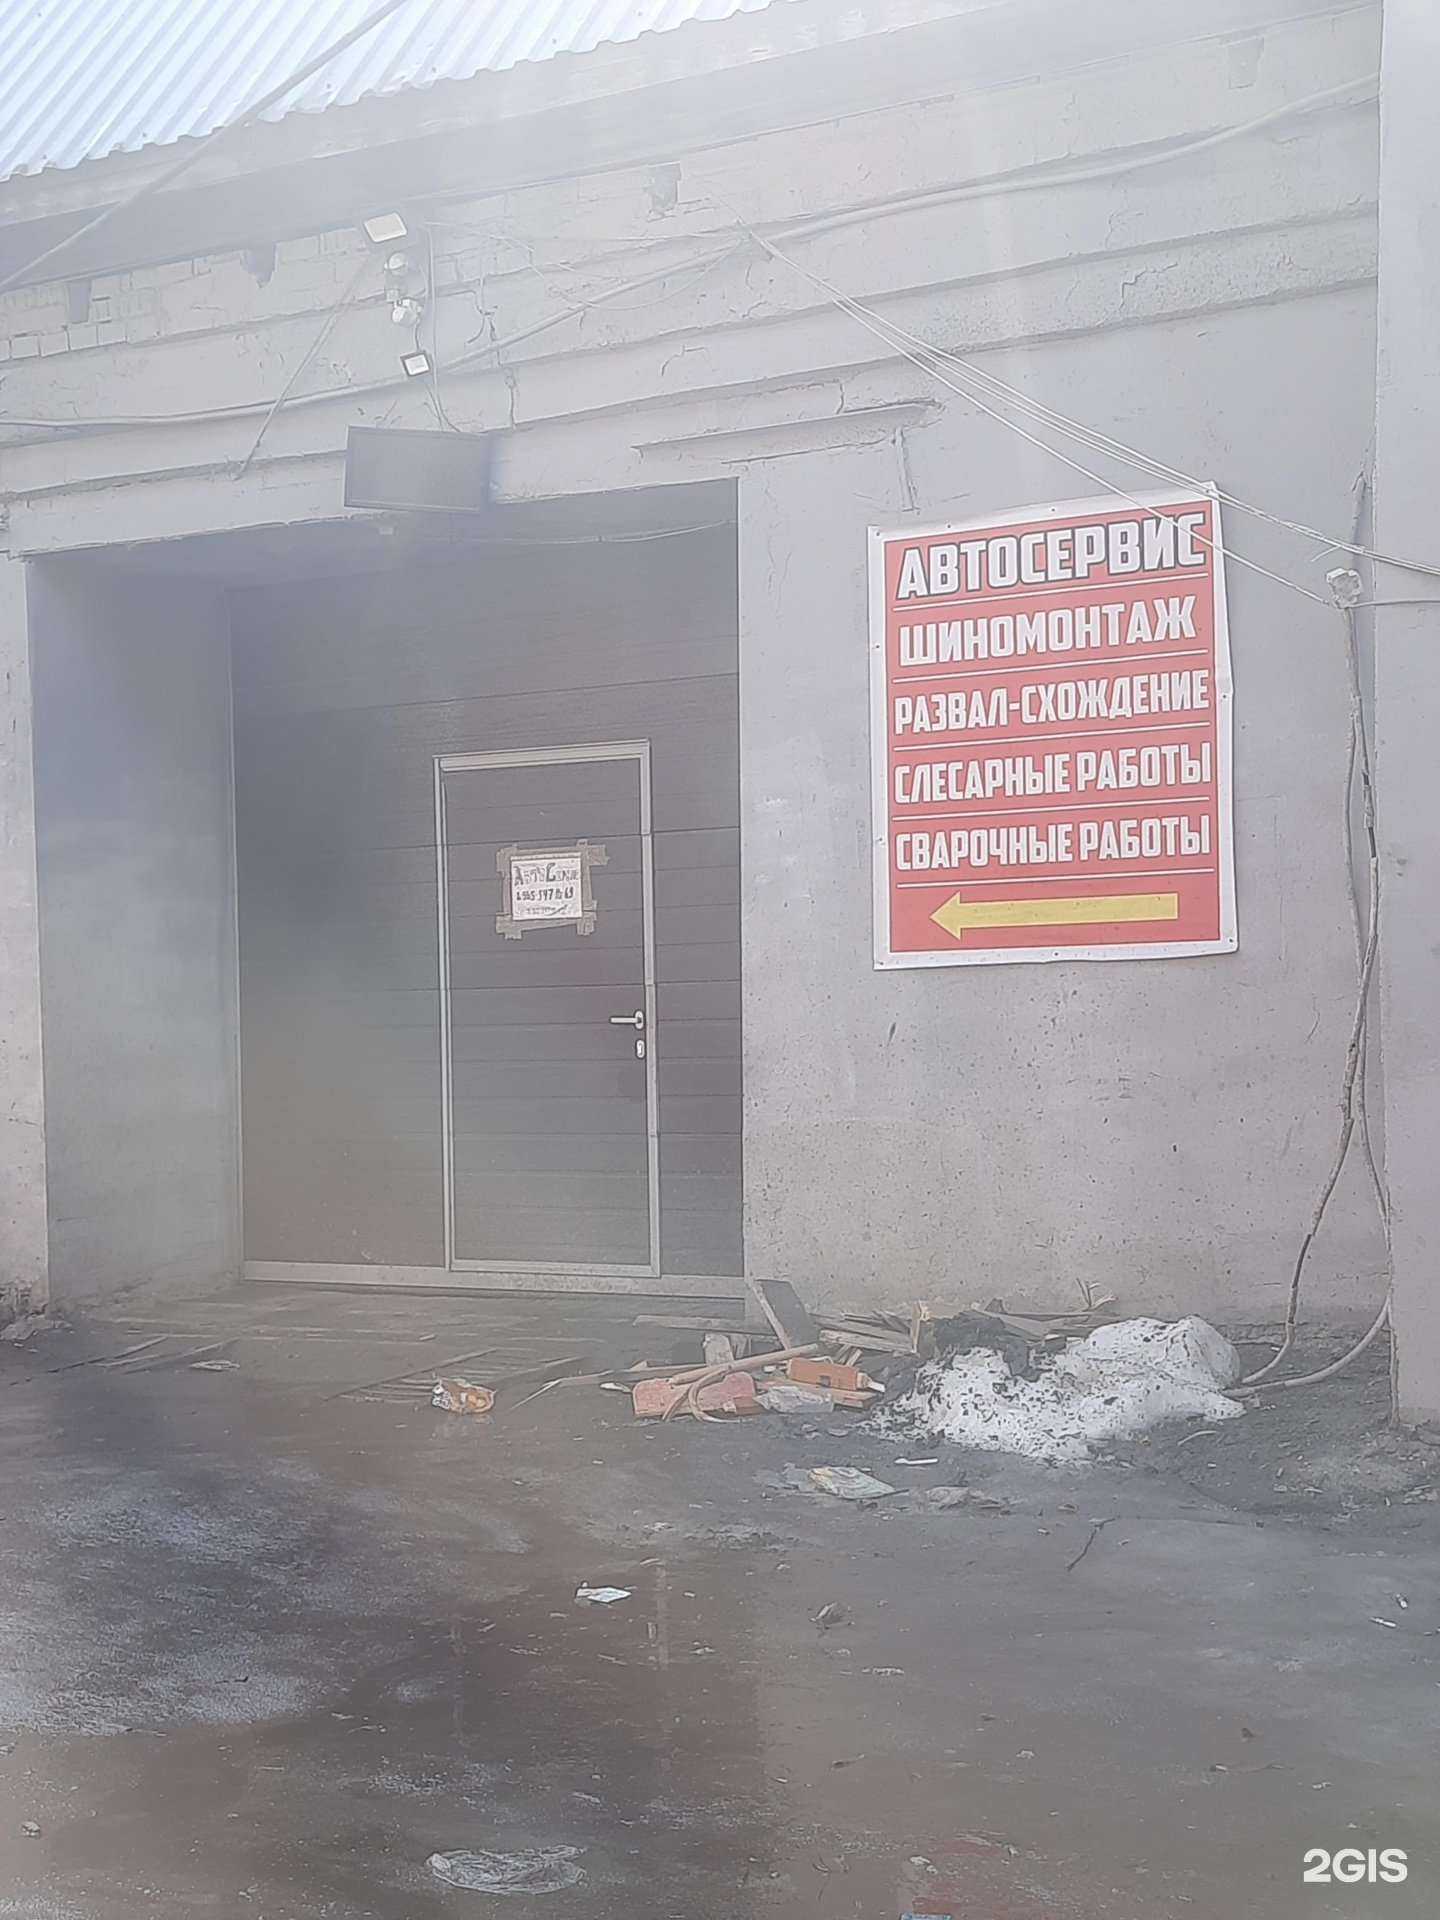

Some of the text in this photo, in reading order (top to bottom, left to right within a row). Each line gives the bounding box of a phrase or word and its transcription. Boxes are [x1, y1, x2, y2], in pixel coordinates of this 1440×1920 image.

[896, 511, 1206, 600] АВТОСЕРВИС
[899, 595, 1197, 667] ШИНОМОНТАЖ
[894, 669, 1210, 735] РАЗВАЛ-СХОЖДЕНИЕ
[894, 742, 1211, 804] СЛЕСАРНЫЕ РАБОТЫ
[895, 815, 1210, 871] СВАРОЧНЫЕ РАБОТЫ
